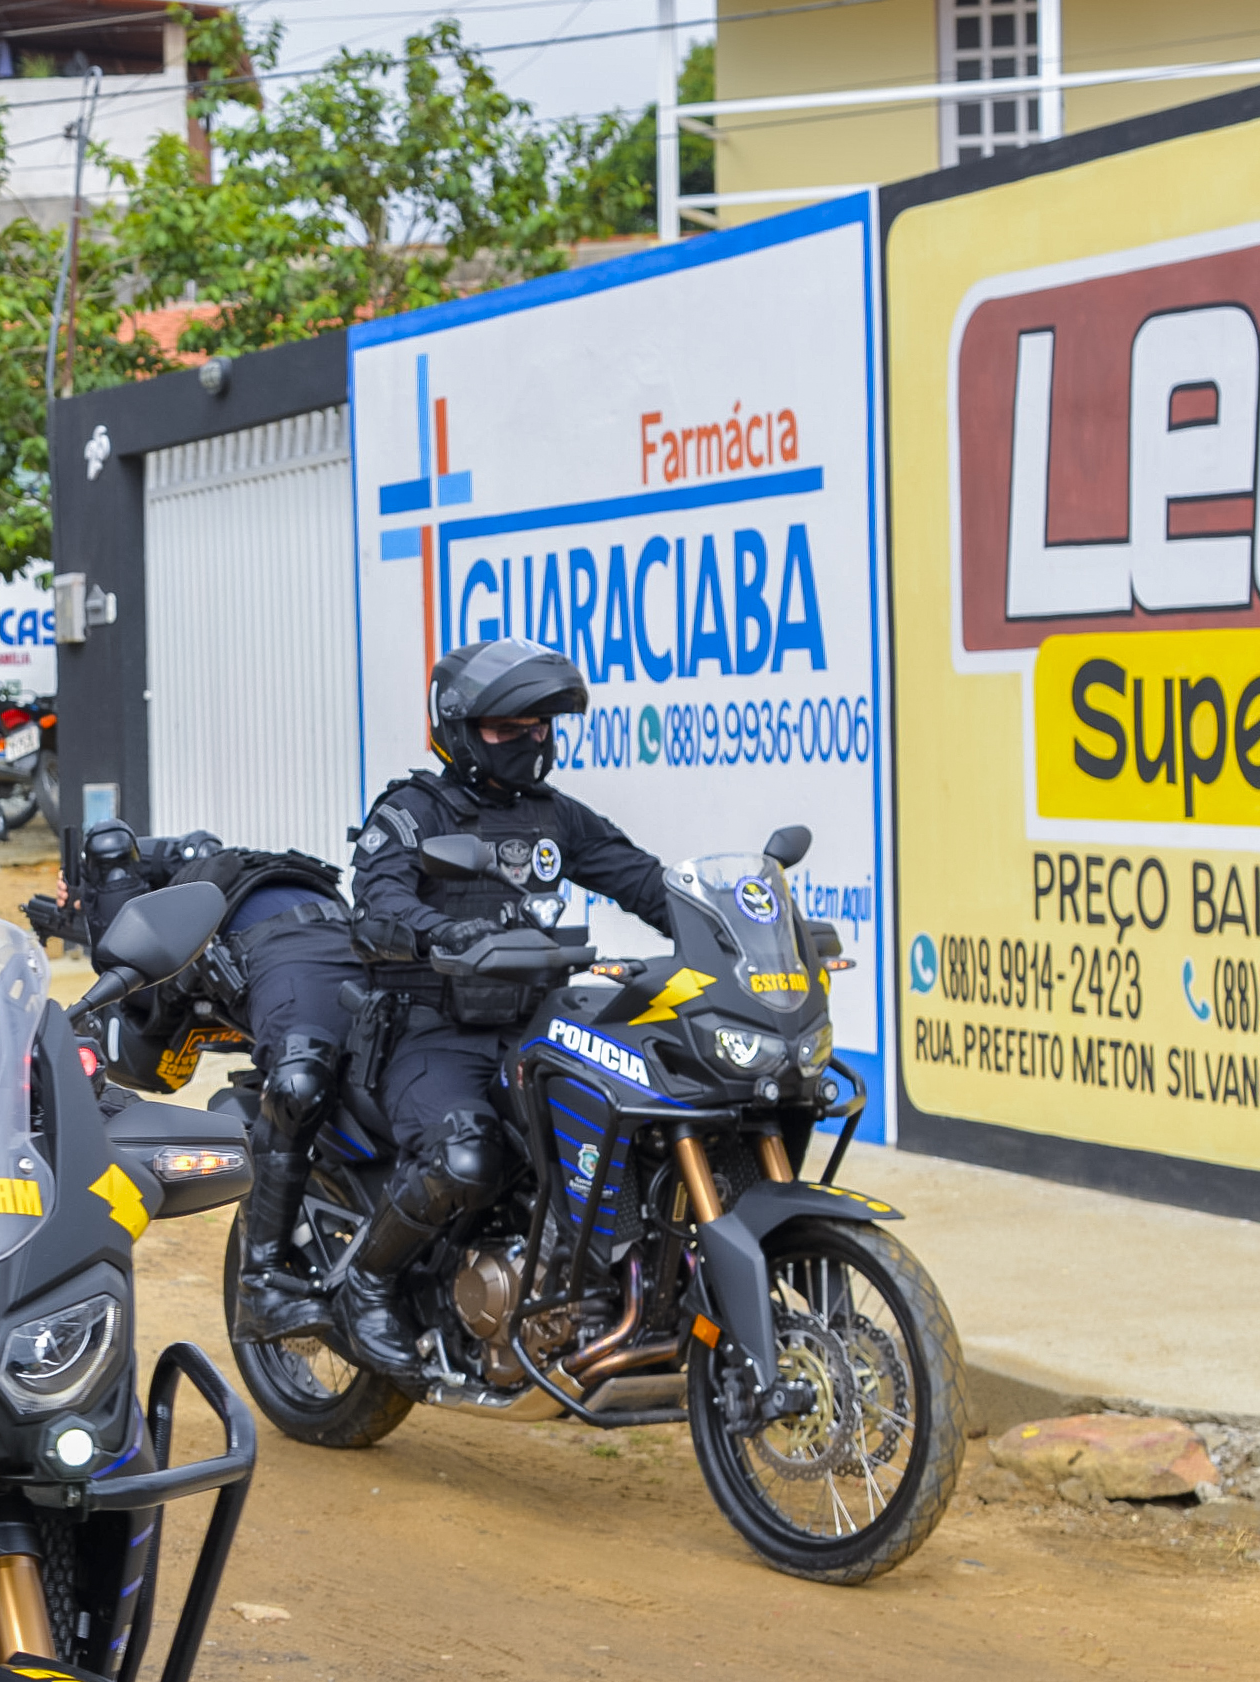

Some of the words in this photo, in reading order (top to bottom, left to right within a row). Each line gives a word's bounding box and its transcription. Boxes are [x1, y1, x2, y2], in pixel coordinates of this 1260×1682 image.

[641, 401, 799, 485] Farmácia
[460, 523, 827, 683] GUARACIABA
[805, 871, 838, 918] tem
[1034, 853, 1168, 944] PREÇO
[941, 934, 1142, 1020] (88)9.9914-2423
[1073, 1034, 1155, 1093] METON
